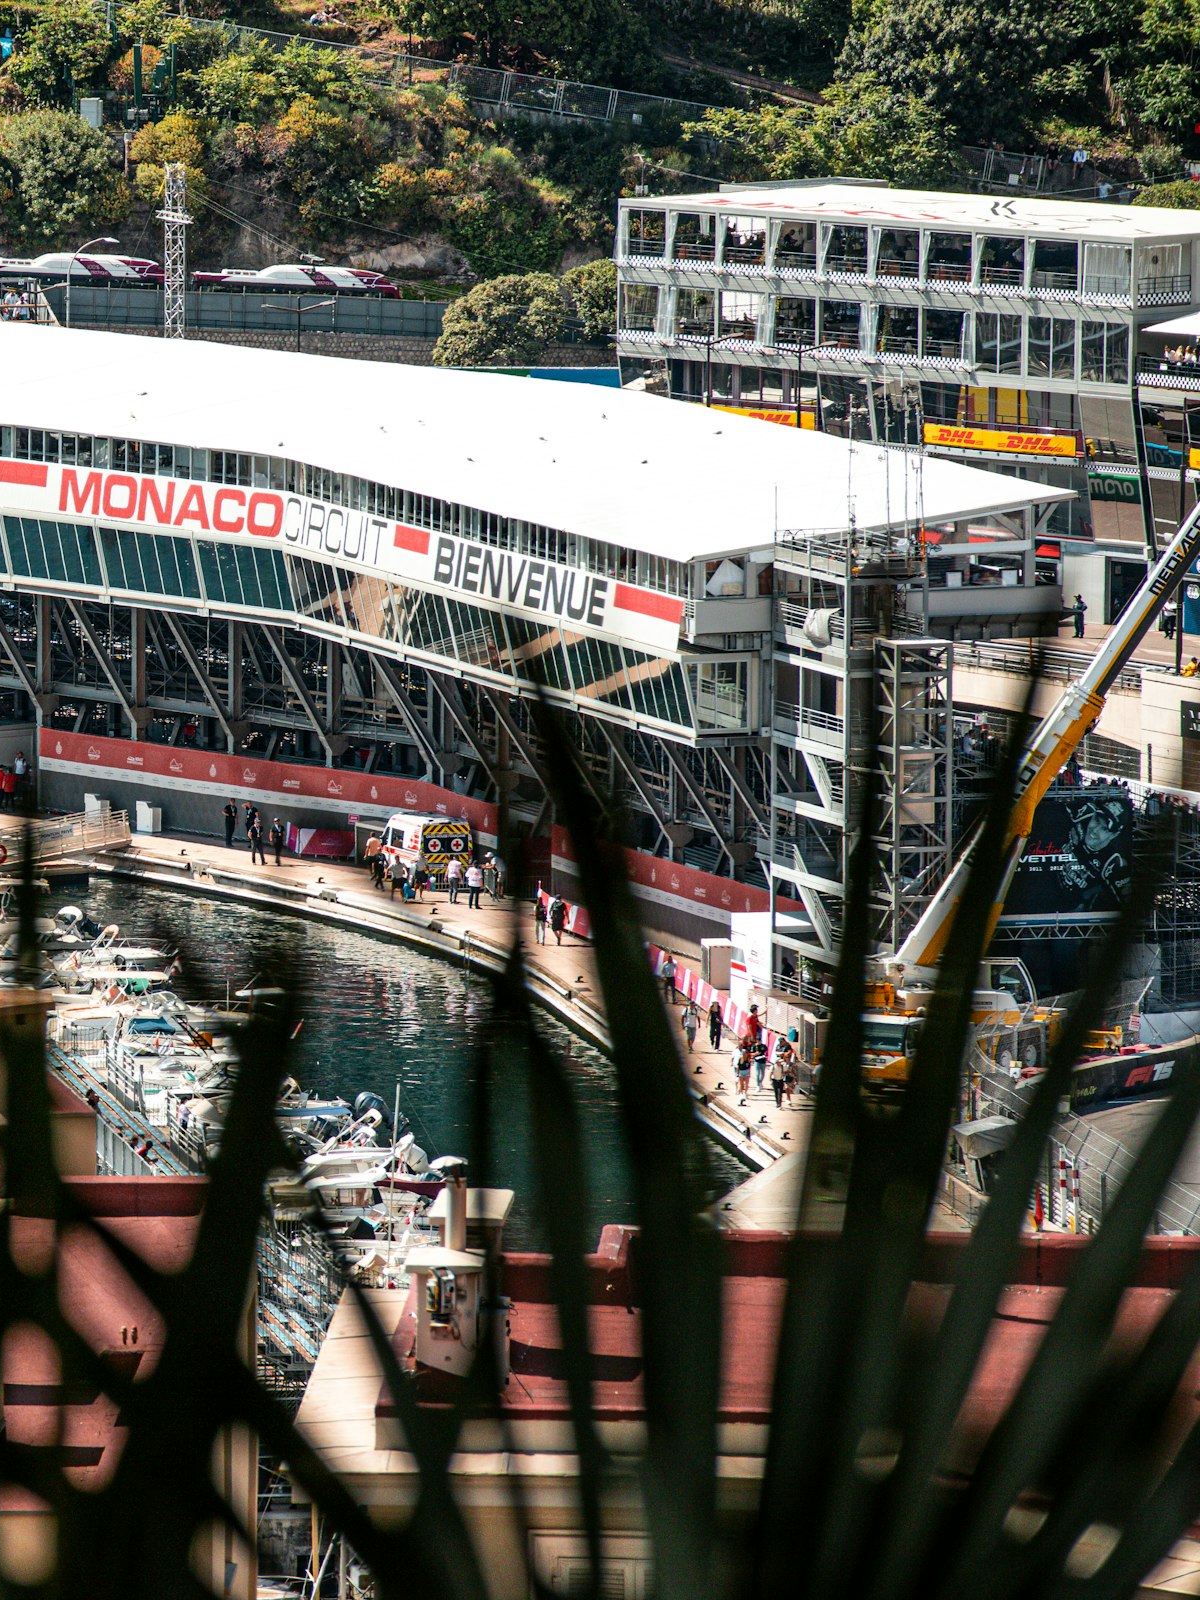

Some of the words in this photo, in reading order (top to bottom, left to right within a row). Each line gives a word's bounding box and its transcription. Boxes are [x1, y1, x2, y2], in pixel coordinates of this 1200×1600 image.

[938, 429, 976, 445] DHL
[1005, 435, 1054, 452] DHL
[433, 536, 608, 627] BIENVENUE
[1019, 854, 1078, 863] VETTEL
